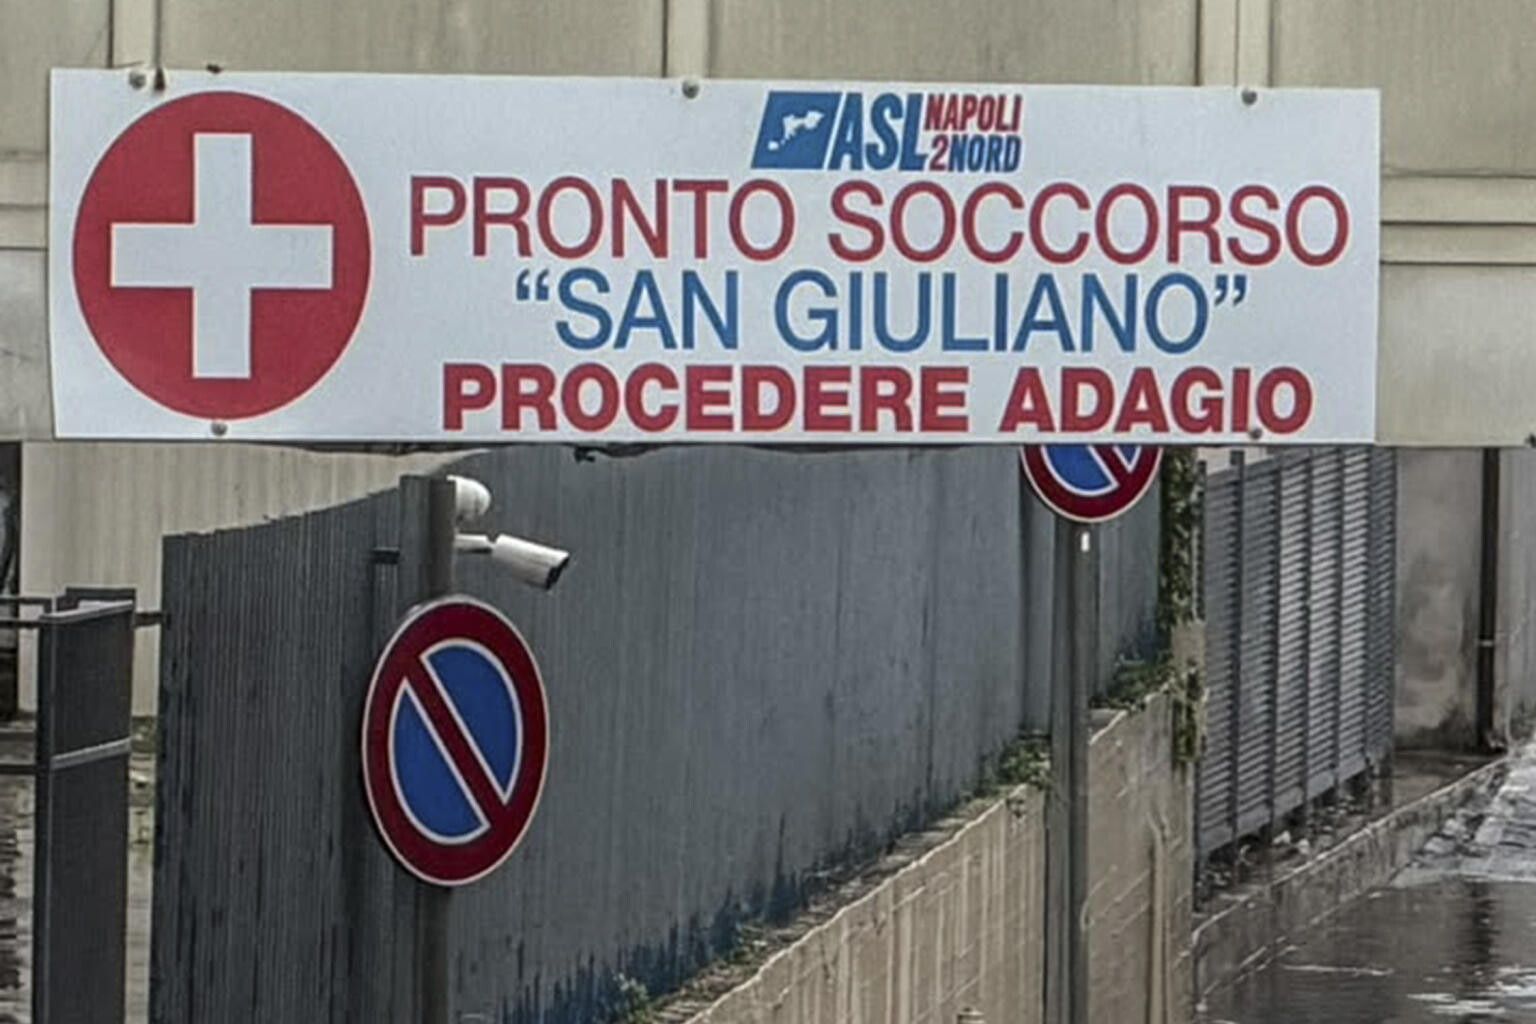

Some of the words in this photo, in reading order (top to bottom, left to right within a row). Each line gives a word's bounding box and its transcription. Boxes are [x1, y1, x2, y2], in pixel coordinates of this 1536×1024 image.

[827, 92, 928, 172] ASL
[923, 93, 1023, 132] NAPOLI
[410, 175, 796, 263] PRONTO
[827, 180, 1351, 267] SOCCORSO
[515, 267, 740, 352] “SAN
[773, 270, 1248, 355] GIULIANO”
[441, 362, 970, 433] PROCEDERE
[998, 365, 1314, 435] ADAGIO
